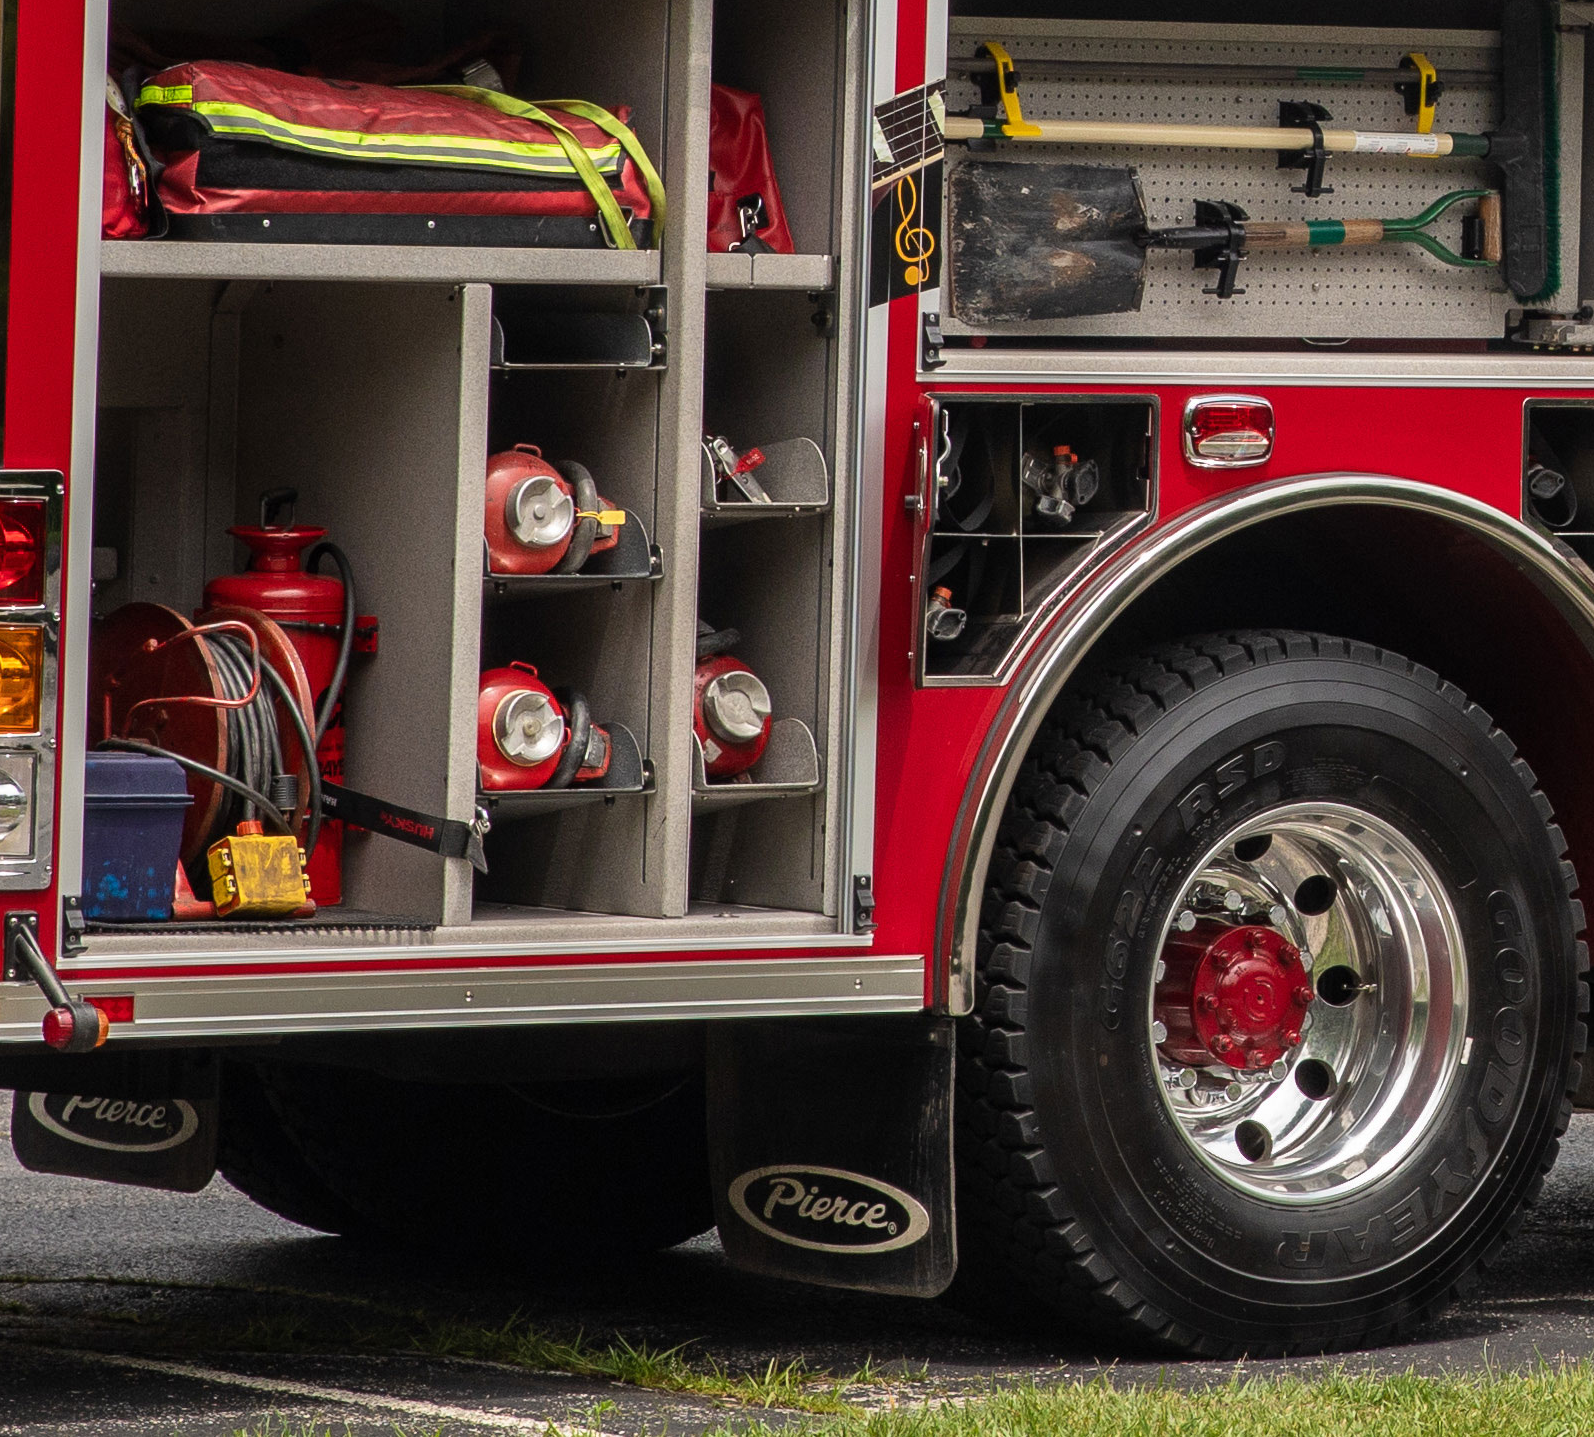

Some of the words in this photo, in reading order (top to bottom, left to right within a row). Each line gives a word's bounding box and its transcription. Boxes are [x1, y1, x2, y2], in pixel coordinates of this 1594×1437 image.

[1177, 740, 1286, 833] RSD
[385, 815, 434, 840] HUSKY
[1276, 888, 1532, 1270] GOODYEAR
[764, 1175, 888, 1230] Pierce
